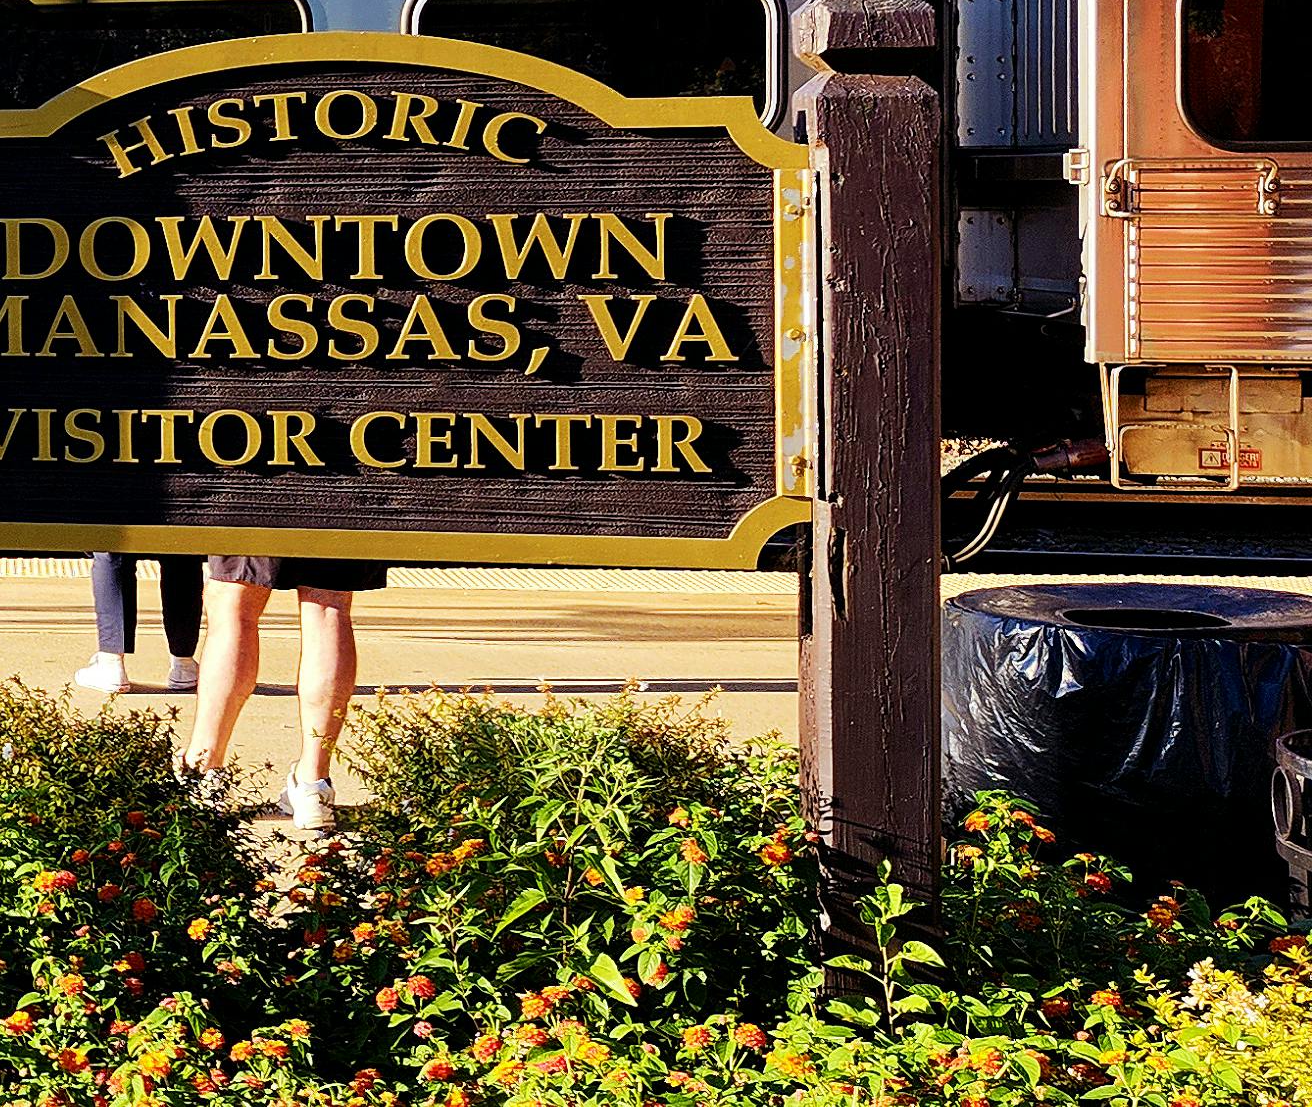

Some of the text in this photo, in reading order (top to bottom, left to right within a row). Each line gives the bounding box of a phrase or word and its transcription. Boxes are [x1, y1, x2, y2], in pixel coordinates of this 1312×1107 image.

[95, 89, 548, 179] HISTORIC
[576, 293, 739, 362] VA
[349, 410, 713, 474] CENTER
